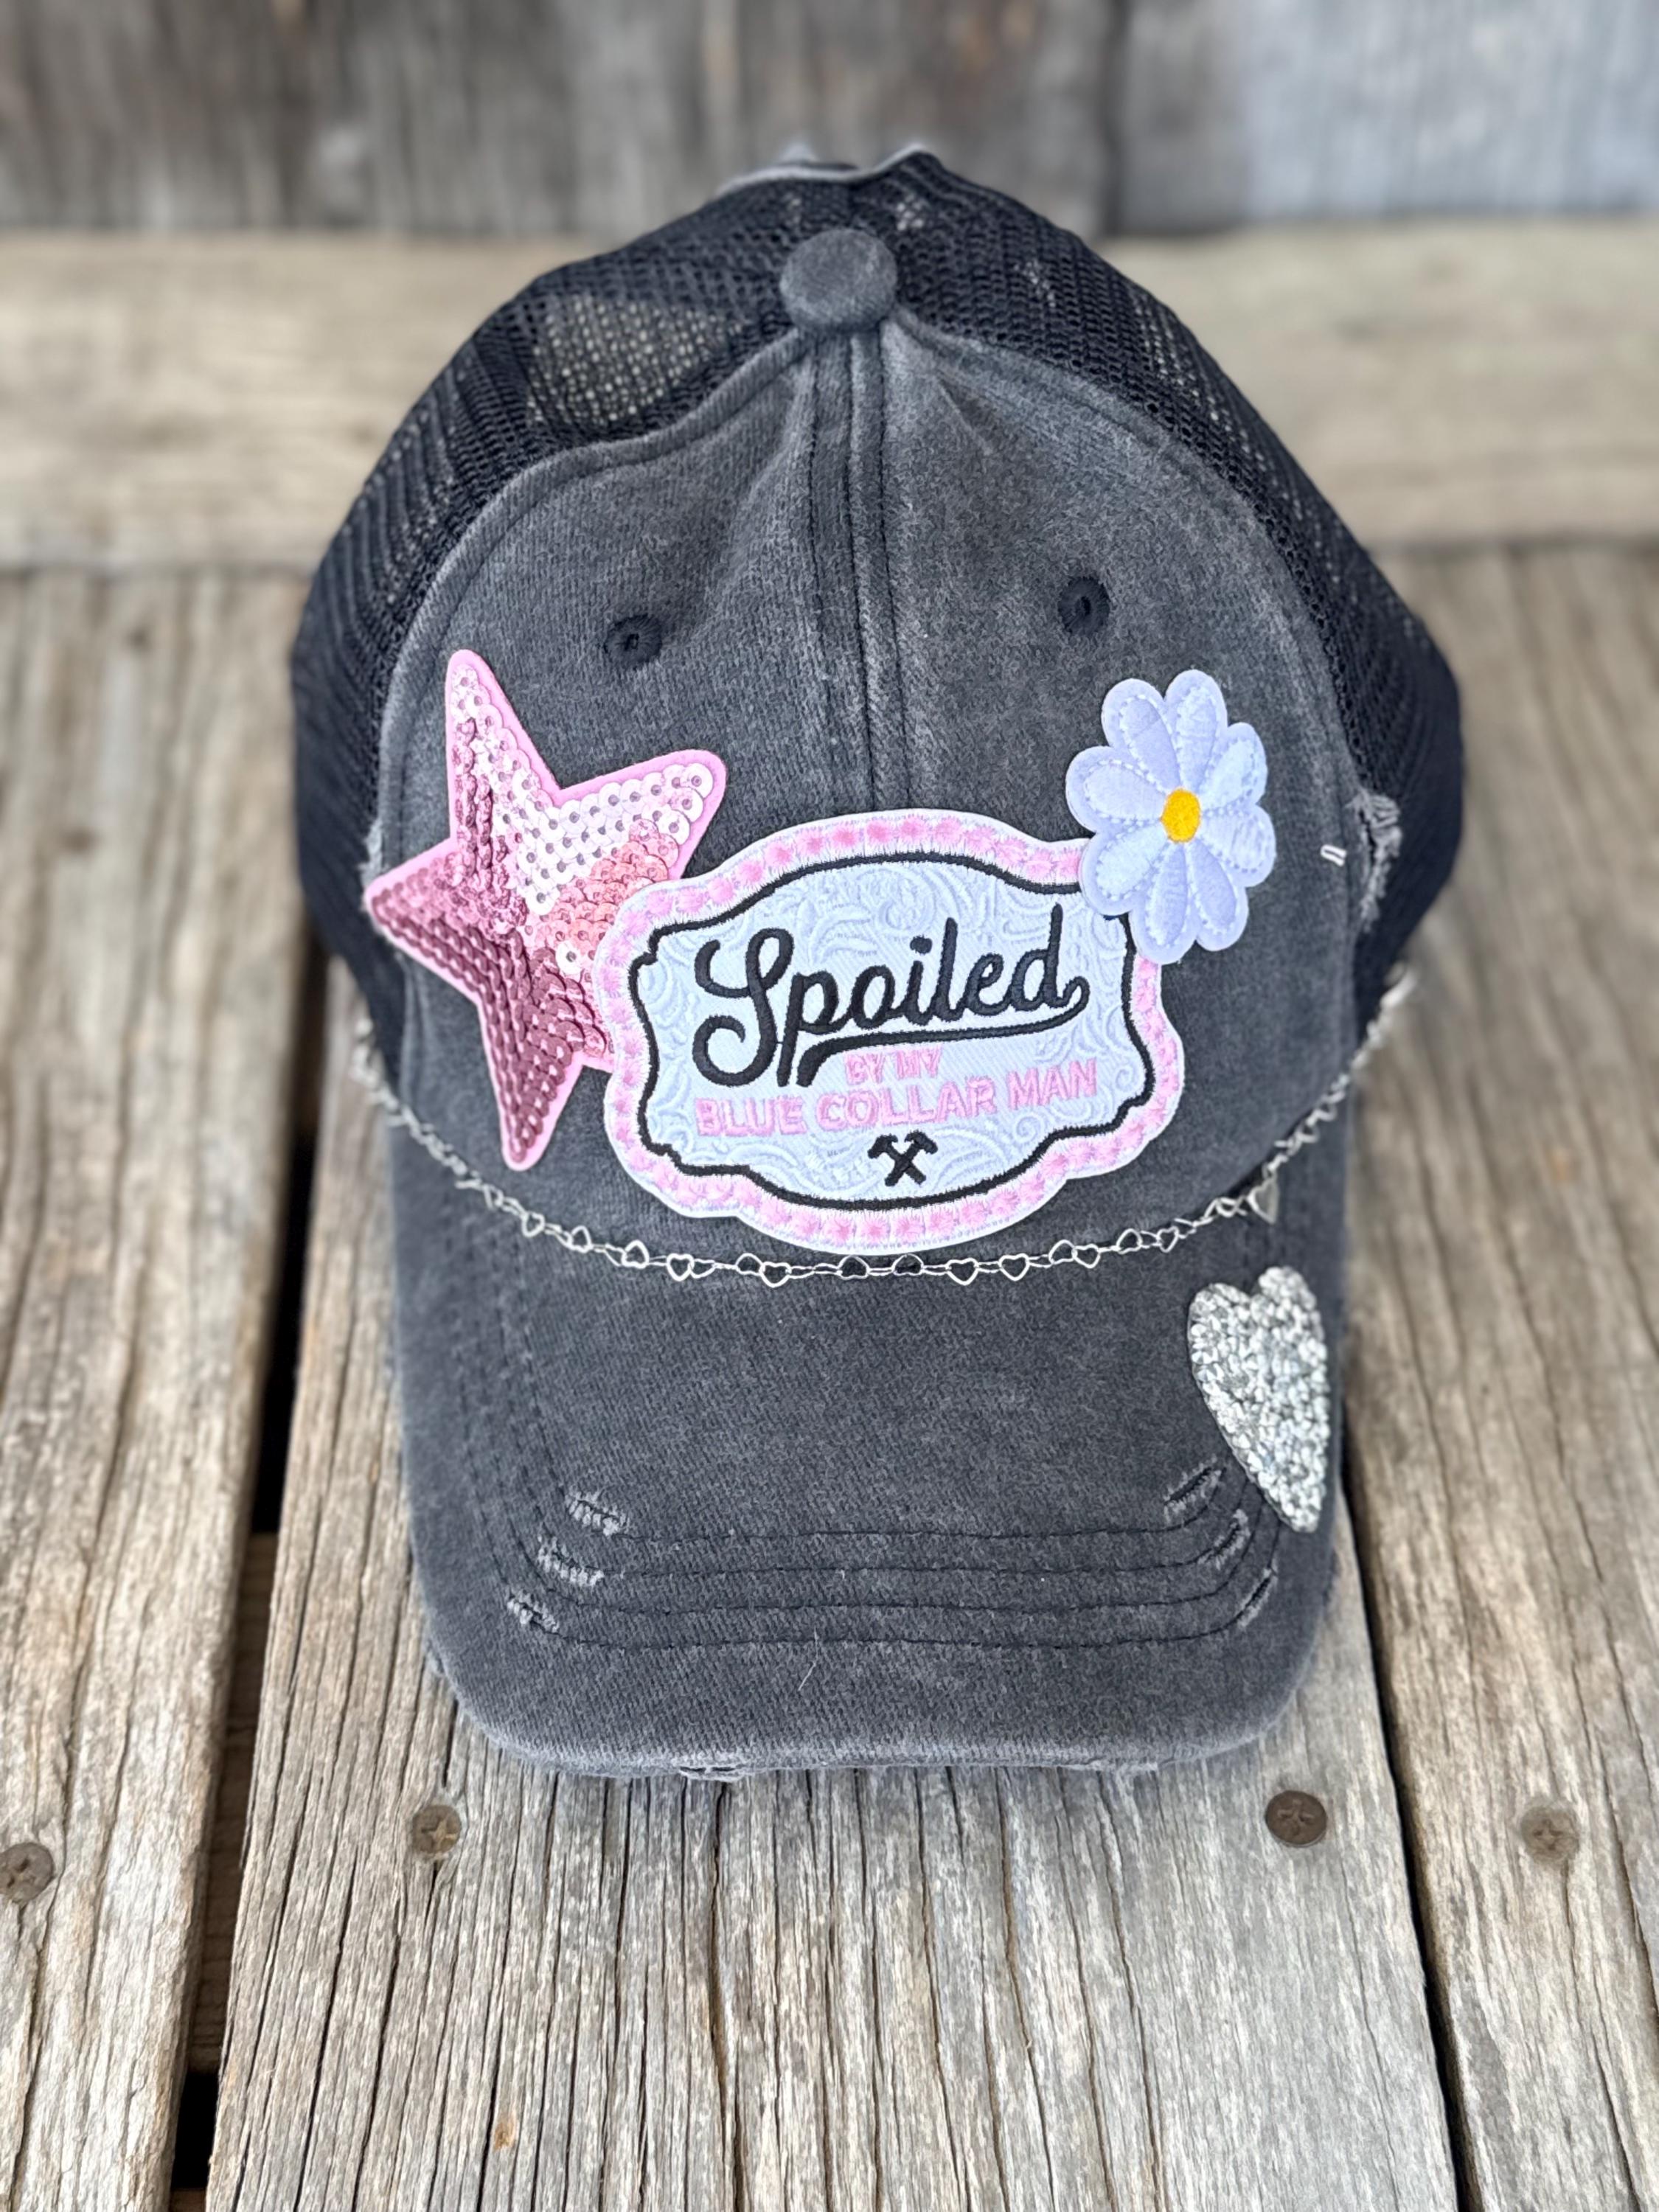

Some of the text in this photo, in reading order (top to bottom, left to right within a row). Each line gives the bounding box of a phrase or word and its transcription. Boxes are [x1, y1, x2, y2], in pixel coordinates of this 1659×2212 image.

[692, 902, 1089, 1087] Spoiled
[695, 1059, 1096, 1136] BLUE COLLAR MAN
[844, 1047, 942, 1085] BY MY
